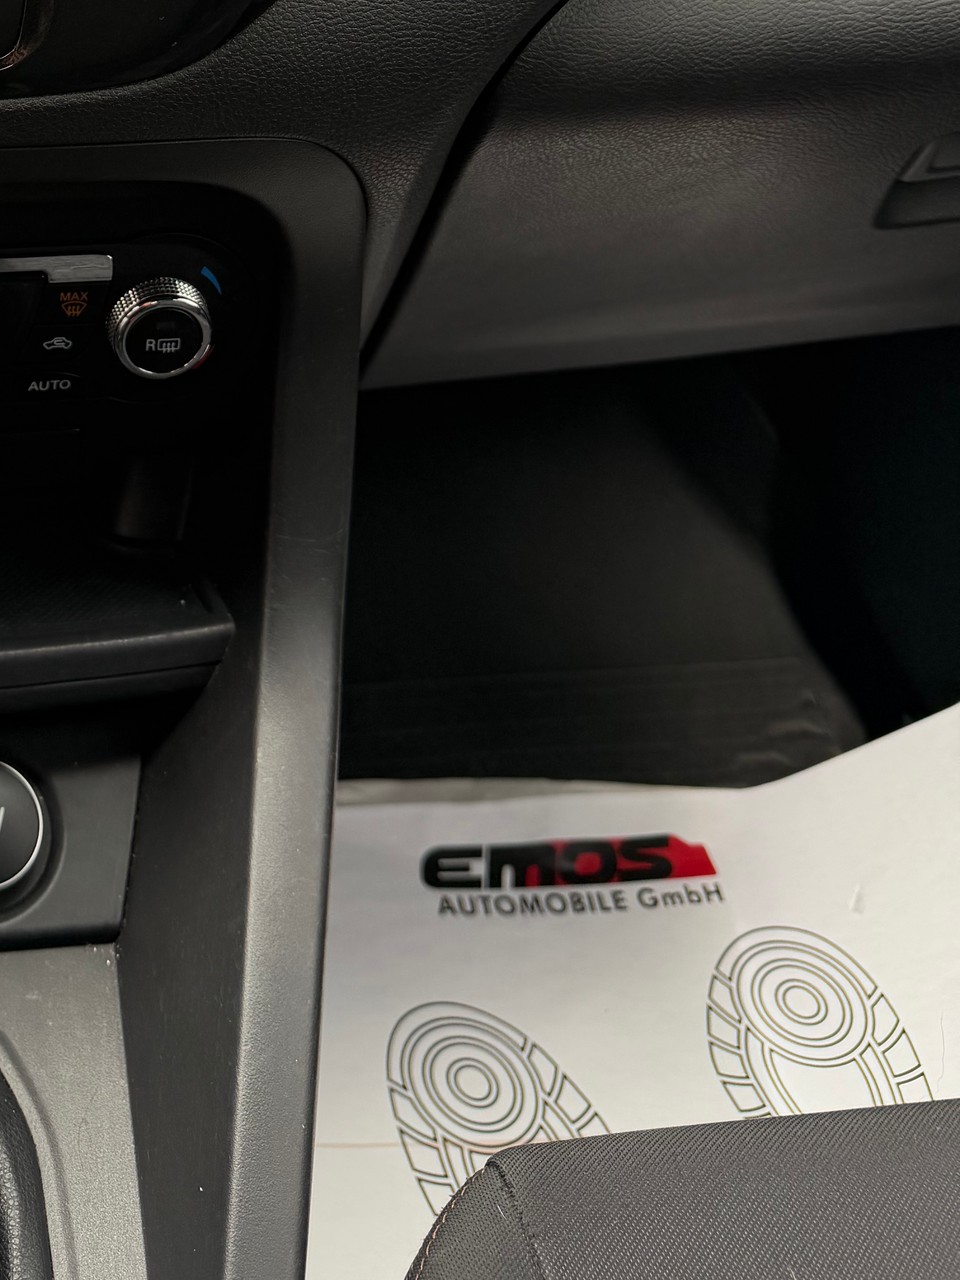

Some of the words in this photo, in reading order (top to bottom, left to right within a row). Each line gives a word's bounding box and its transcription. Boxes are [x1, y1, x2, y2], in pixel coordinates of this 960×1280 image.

[59, 291, 89, 302] MAX
[145, 339, 156, 351] R
[27, 378, 71, 393] AUTO
[438, 888, 628, 917] AUTOMOBILE
[638, 881, 724, 909] GmbH
